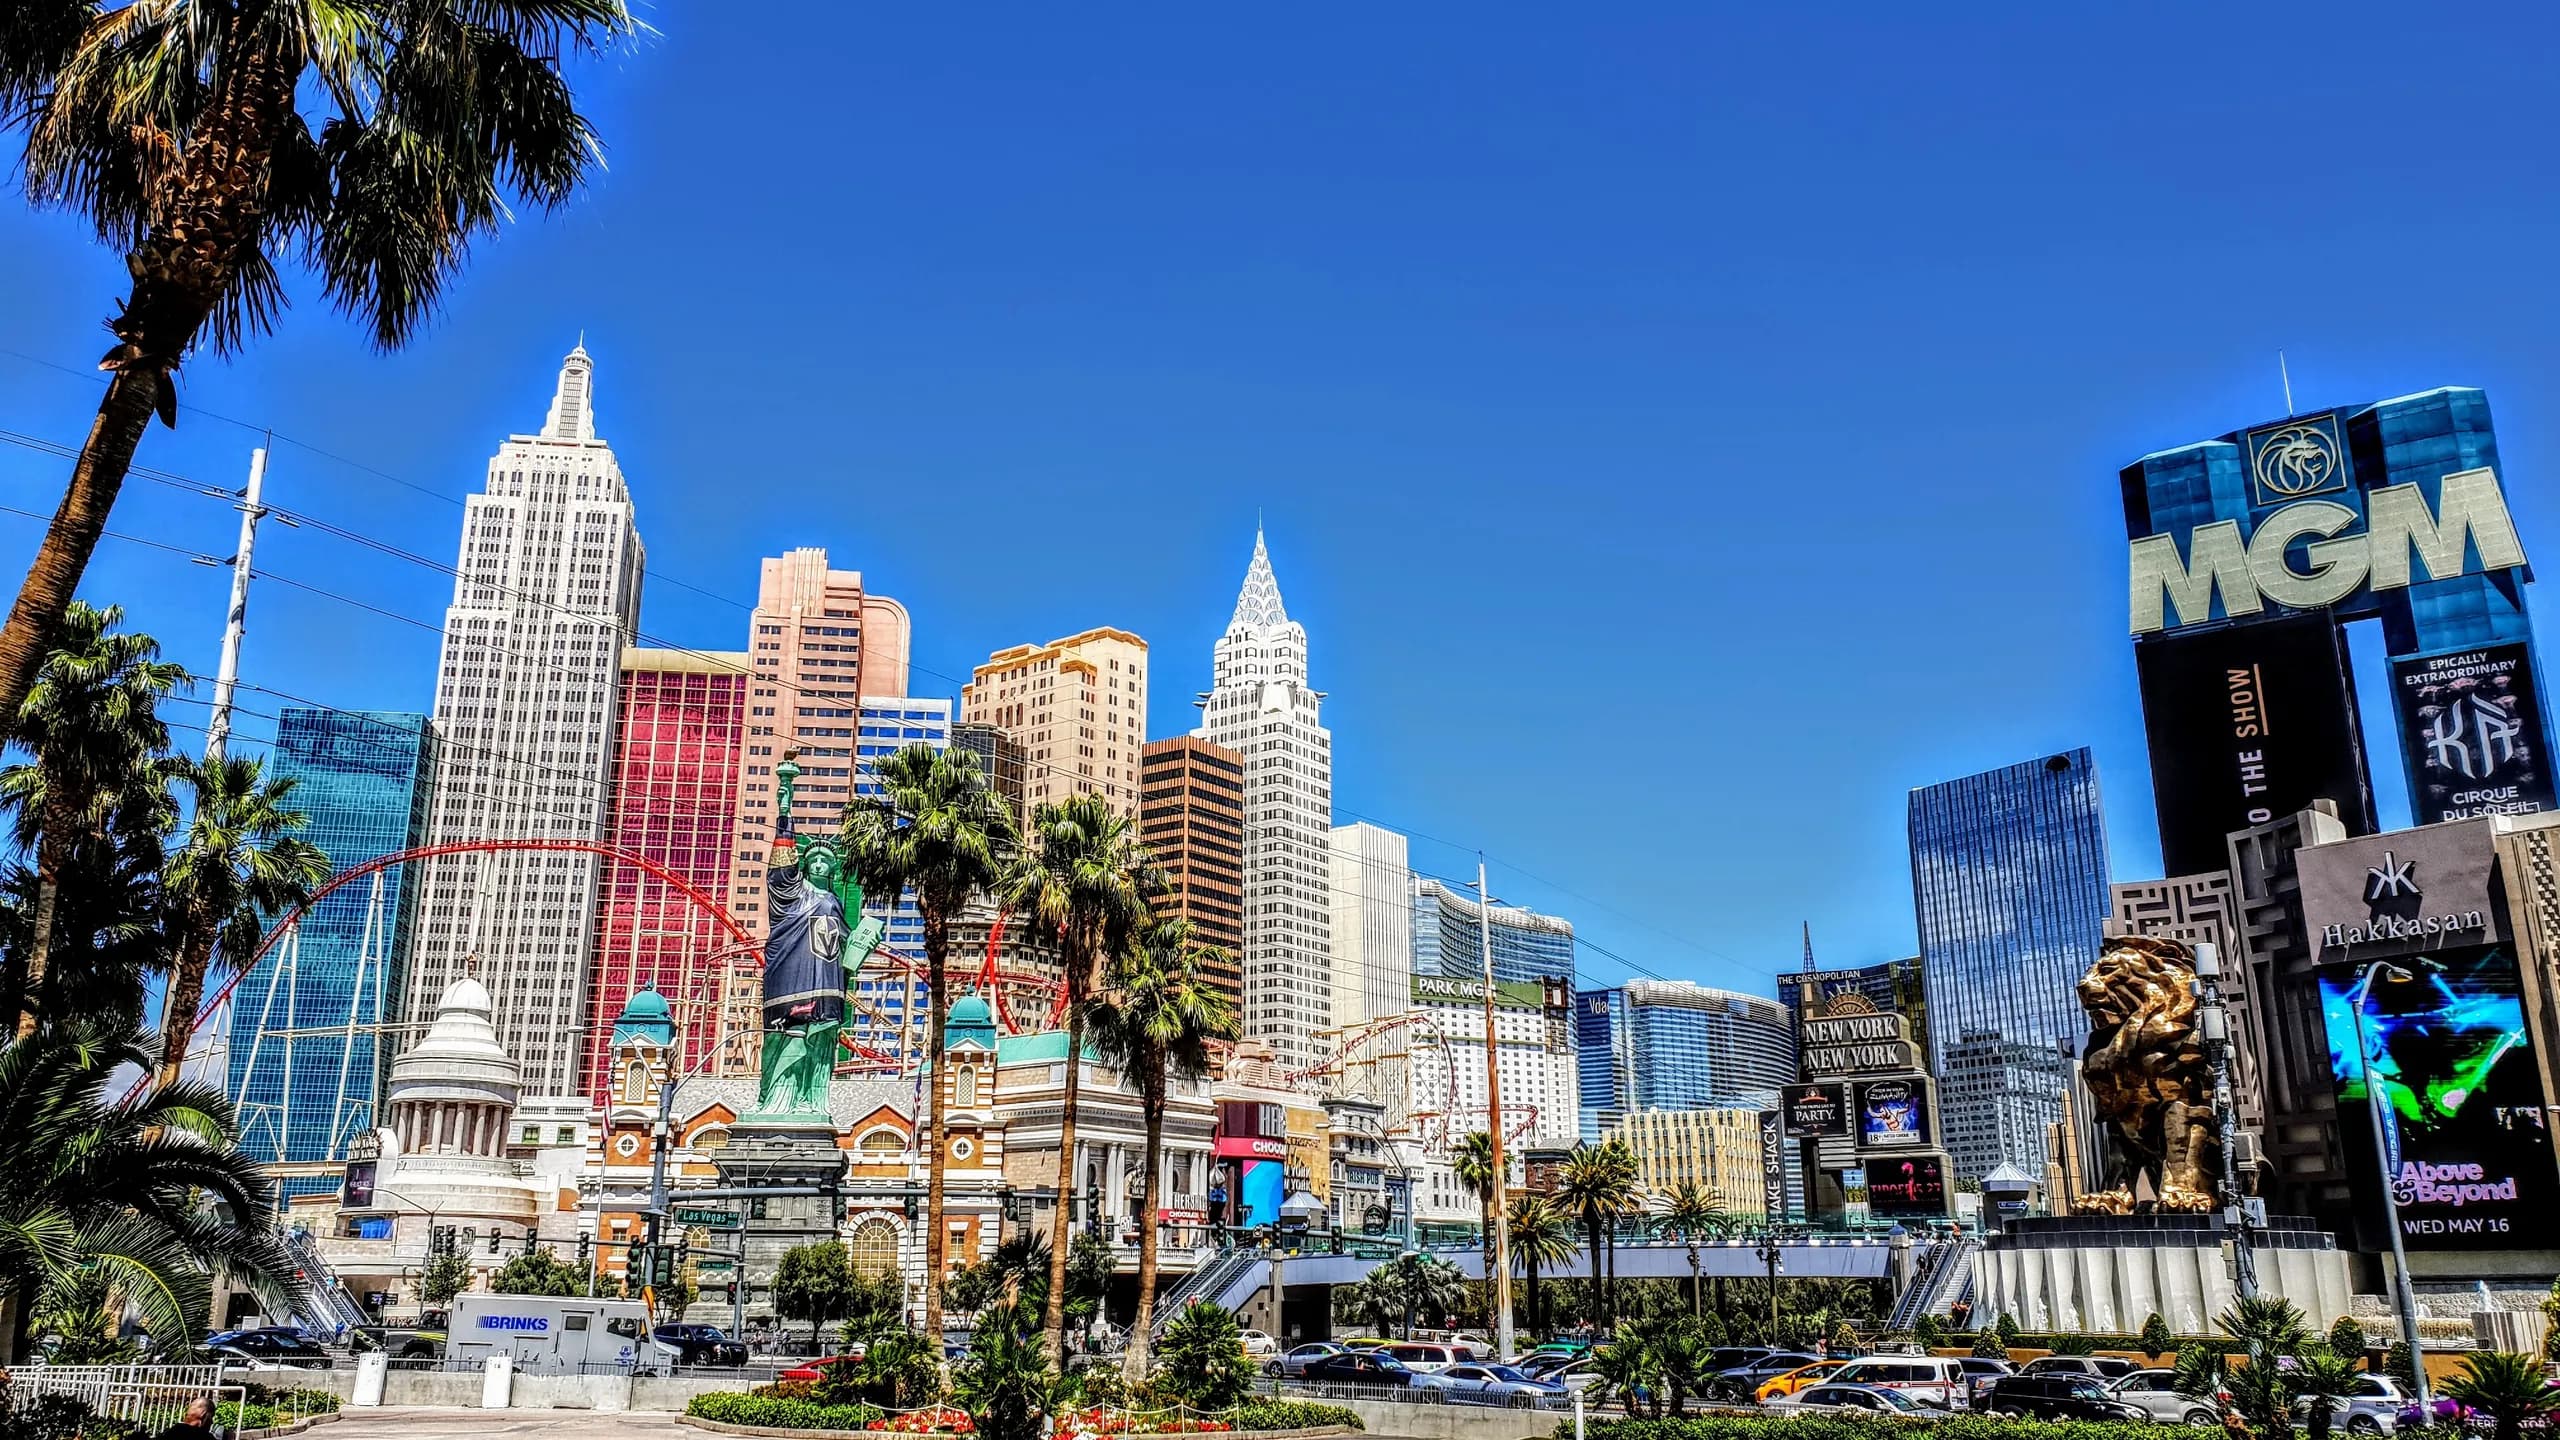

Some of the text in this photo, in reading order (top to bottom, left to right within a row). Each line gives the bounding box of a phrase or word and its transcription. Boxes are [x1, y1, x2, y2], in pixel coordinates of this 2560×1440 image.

[2129, 466, 2527, 635] MGM
[2429, 652, 2487, 670] EPICALLY
[2405, 659, 2517, 685] EXTRAORDINARY
[2227, 669, 2272, 828] O THE SHOW
[2452, 786, 2519, 803] CIRQUE
[2442, 801, 2534, 821] DU SOLEIL
[2322, 909, 2486, 948] Hakkasan
[1778, 970, 1860, 984] THE COSMOPOLITAN
[1420, 979, 1497, 998] PARK MG
[1805, 1017, 1898, 1043] NEW YORK
[1807, 1044, 1900, 1069] NEW YORK
[1795, 1109, 1835, 1121] PARTY.
[1763, 1123, 1779, 1174] SHACK
[1366, 1174, 1379, 1185] PUB
[2401, 1161, 2484, 1182] Above
[2392, 1177, 2518, 1206] & Beyond
[683, 1210, 699, 1220] Las
[701, 1211, 726, 1224] Vegas
[2404, 1218, 2510, 1234] WED MAY 16
[488, 1316, 548, 1330] BRINKS
